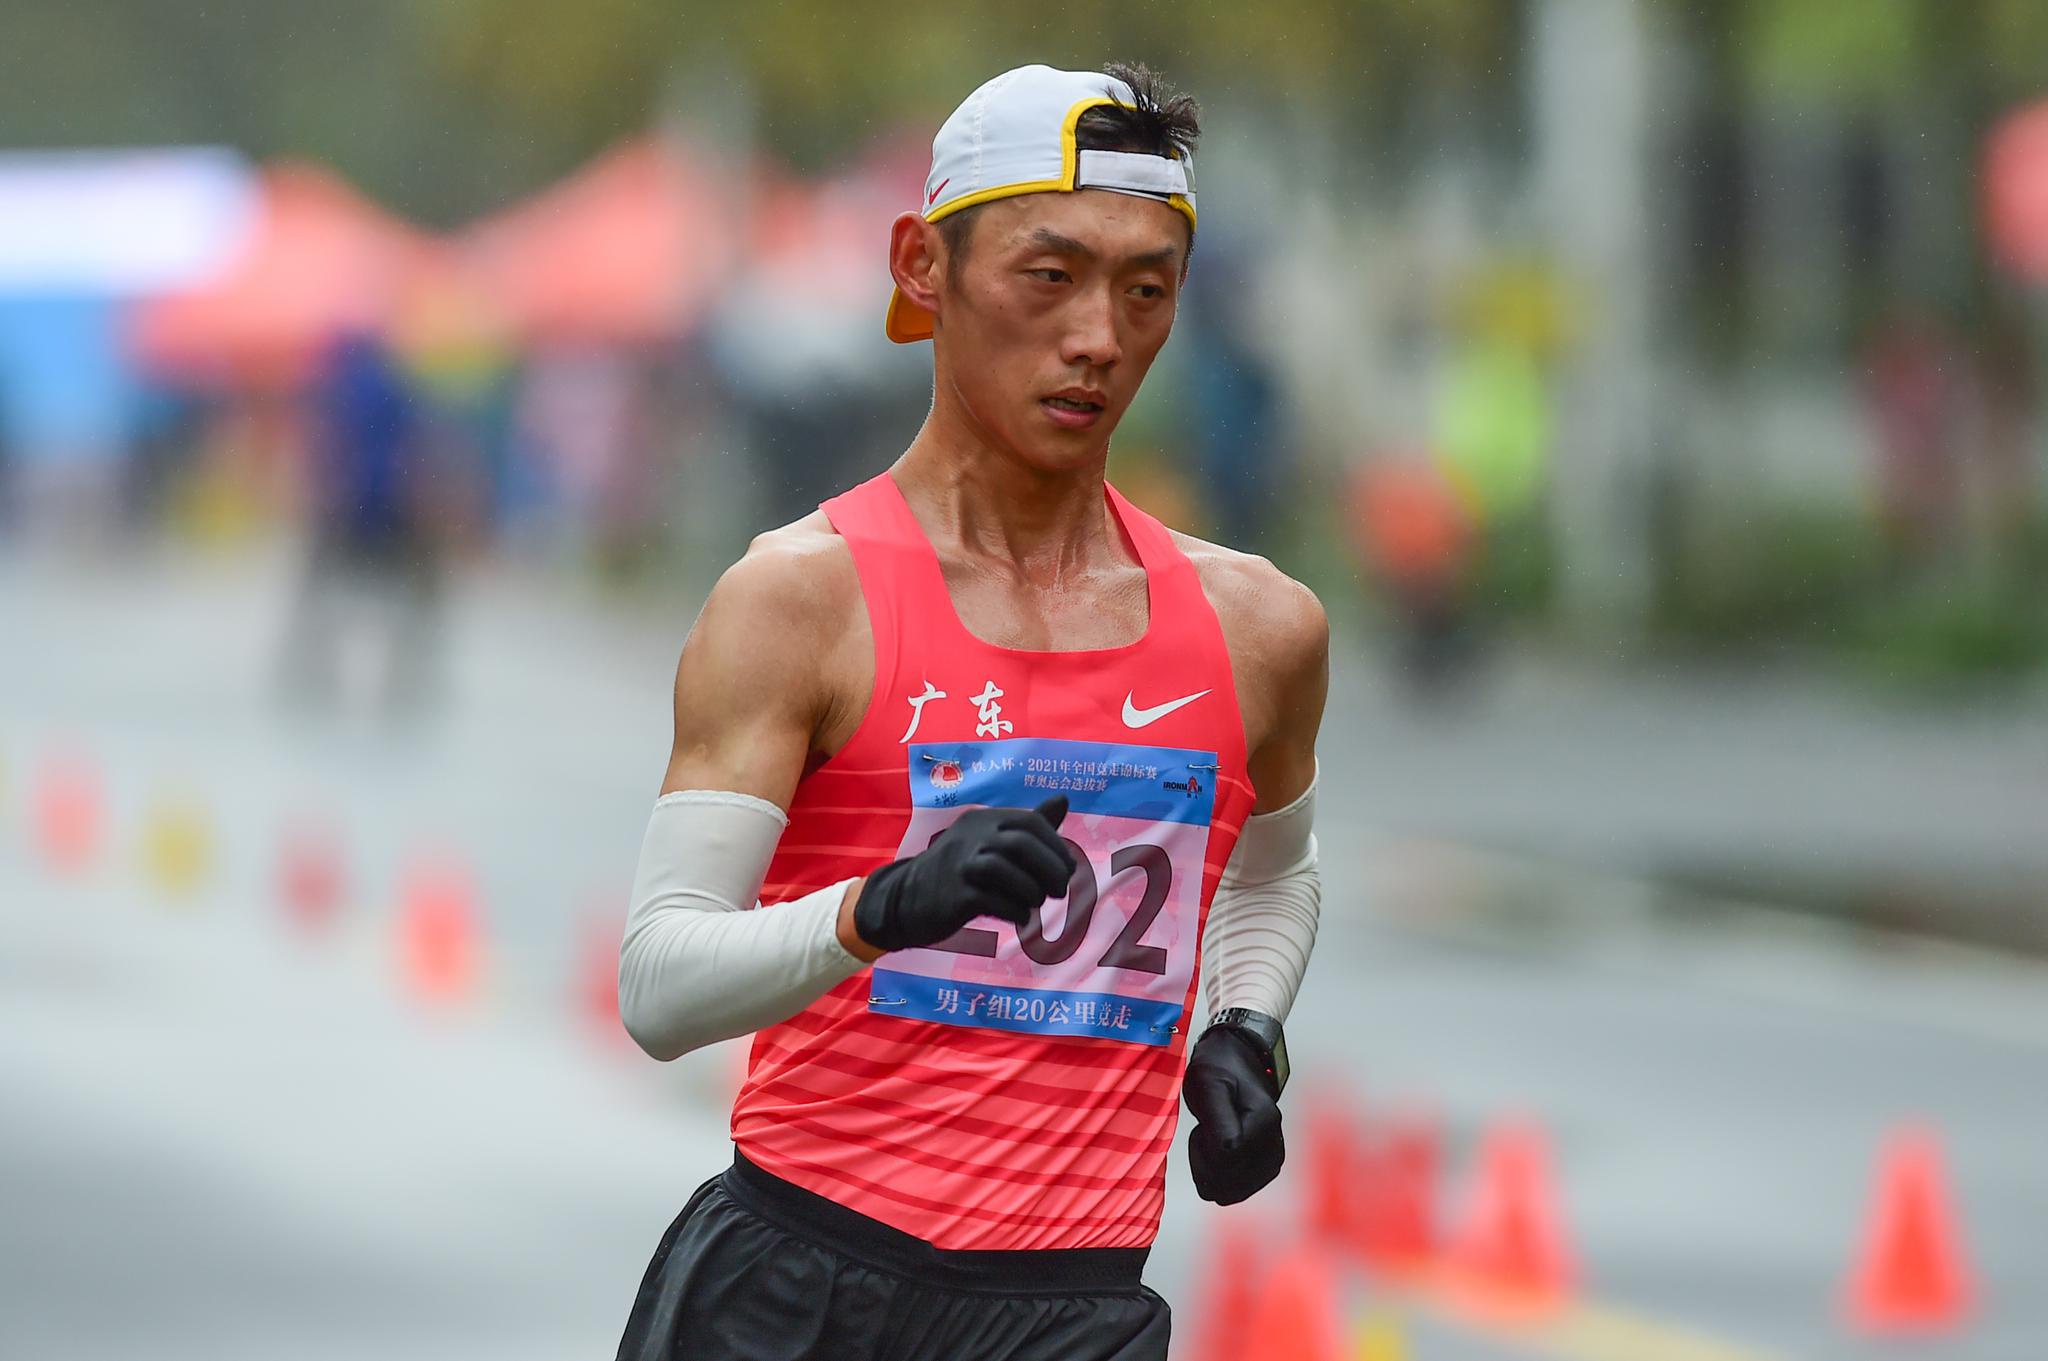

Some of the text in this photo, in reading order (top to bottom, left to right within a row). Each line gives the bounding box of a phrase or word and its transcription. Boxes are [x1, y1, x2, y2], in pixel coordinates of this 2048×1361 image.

[899, 680, 1014, 744] 广东
[911, 828, 1173, 976] 02
[933, 987, 1133, 1031] 男子组20公里竞走
